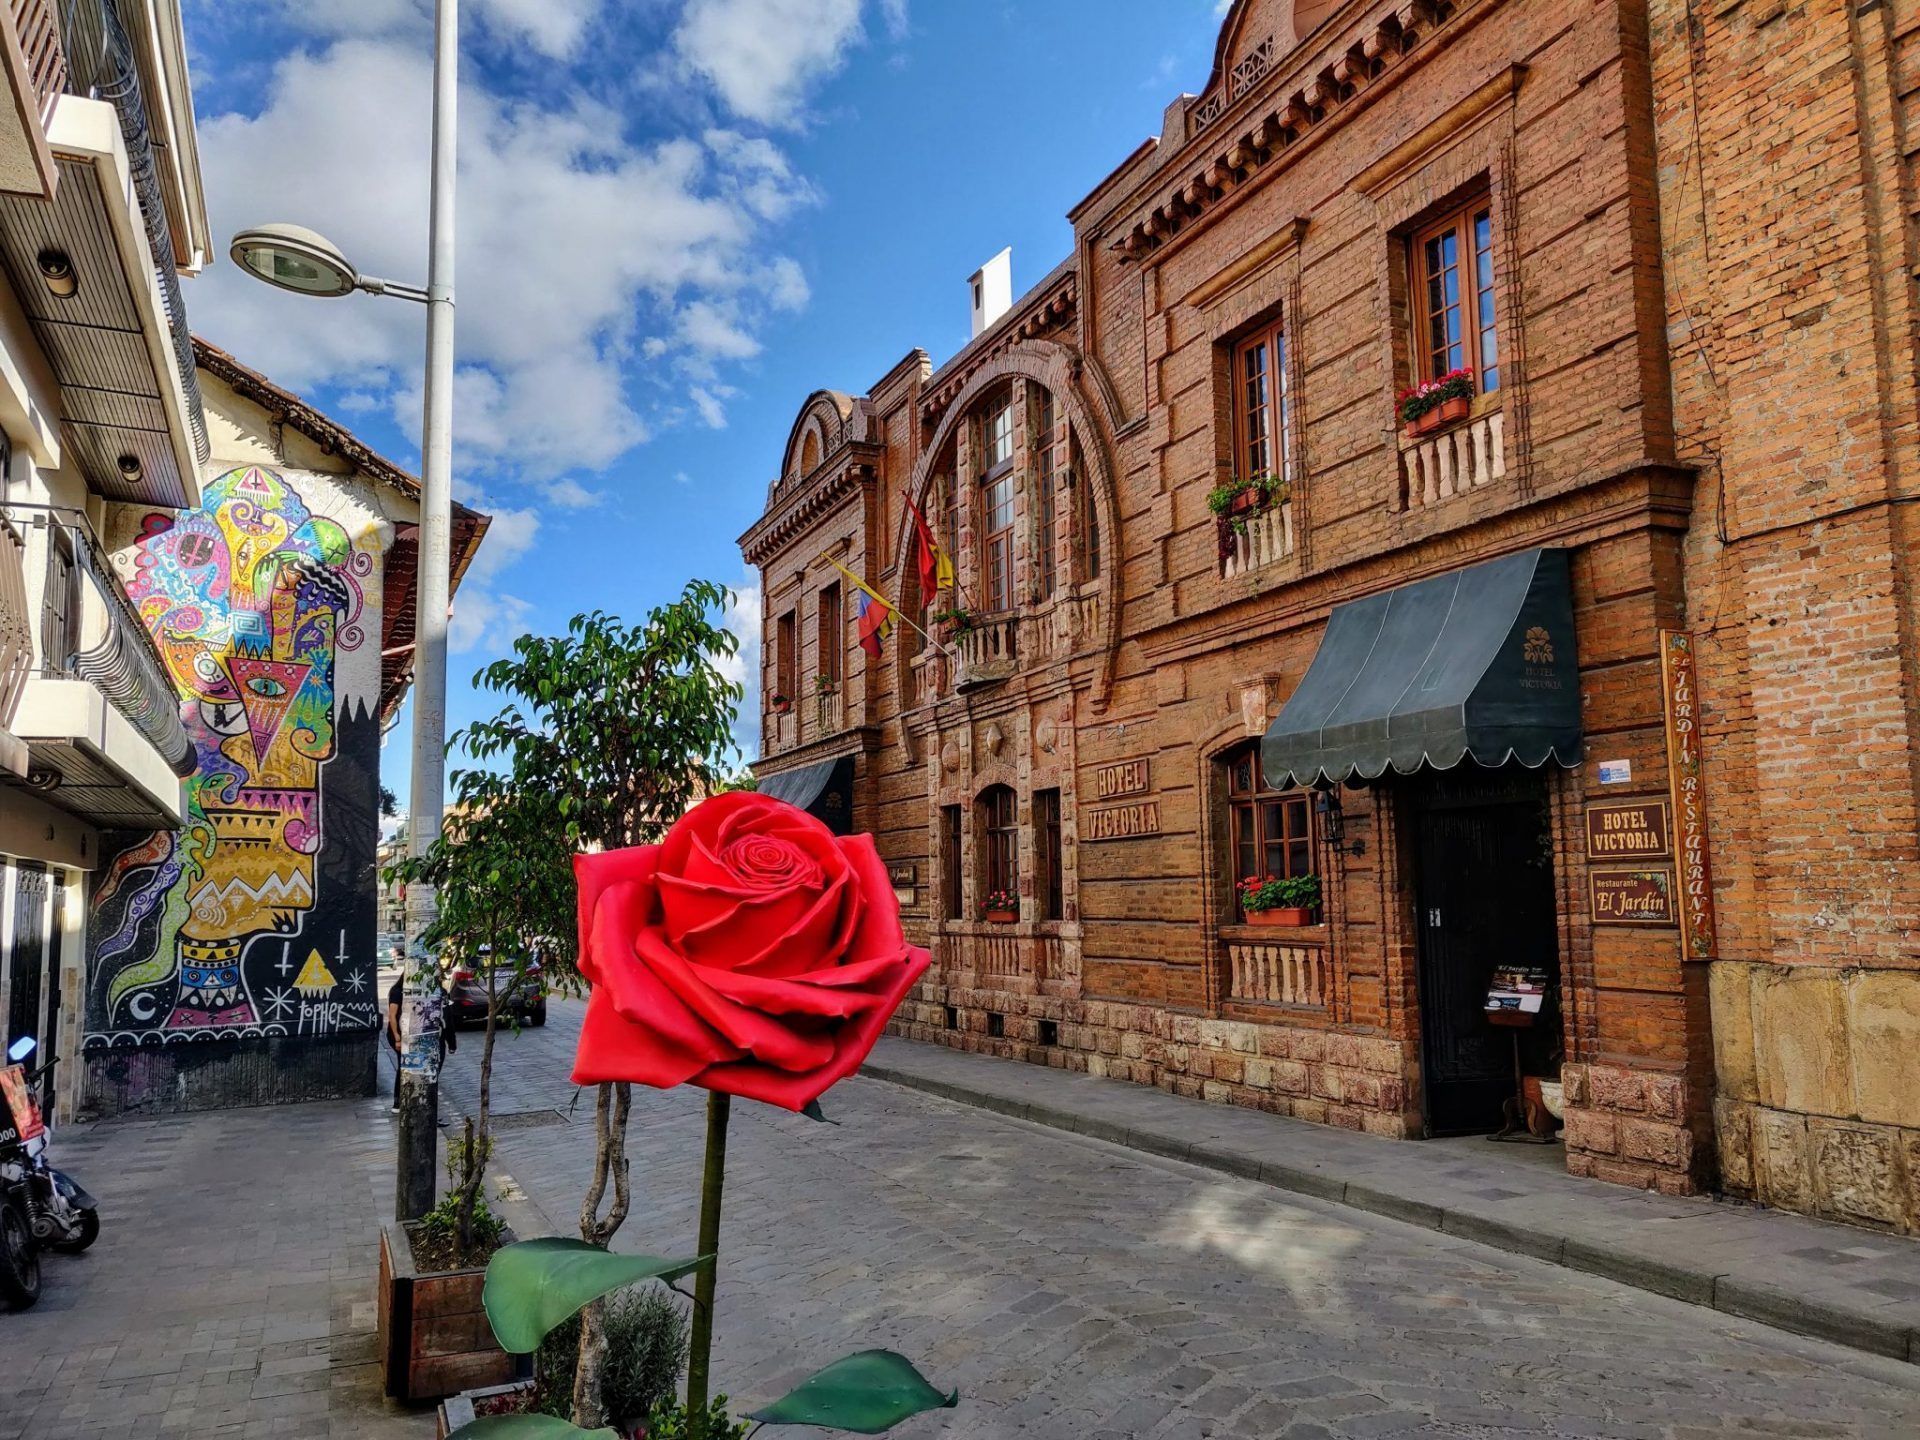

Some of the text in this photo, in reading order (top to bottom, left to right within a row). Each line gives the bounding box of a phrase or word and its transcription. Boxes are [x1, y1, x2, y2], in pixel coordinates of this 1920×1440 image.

[1099, 764, 1143, 795] HOTEL
[1671, 656, 1708, 925] EL JARDIN RESTAURANT
[1089, 805, 1158, 837] VICTORIA
[1604, 811, 1648, 830] HOTEL
[1595, 831, 1659, 851] VICTORIA
[1597, 879, 1638, 888] Restaurante
[1597, 890, 1665, 916] El Jardín
